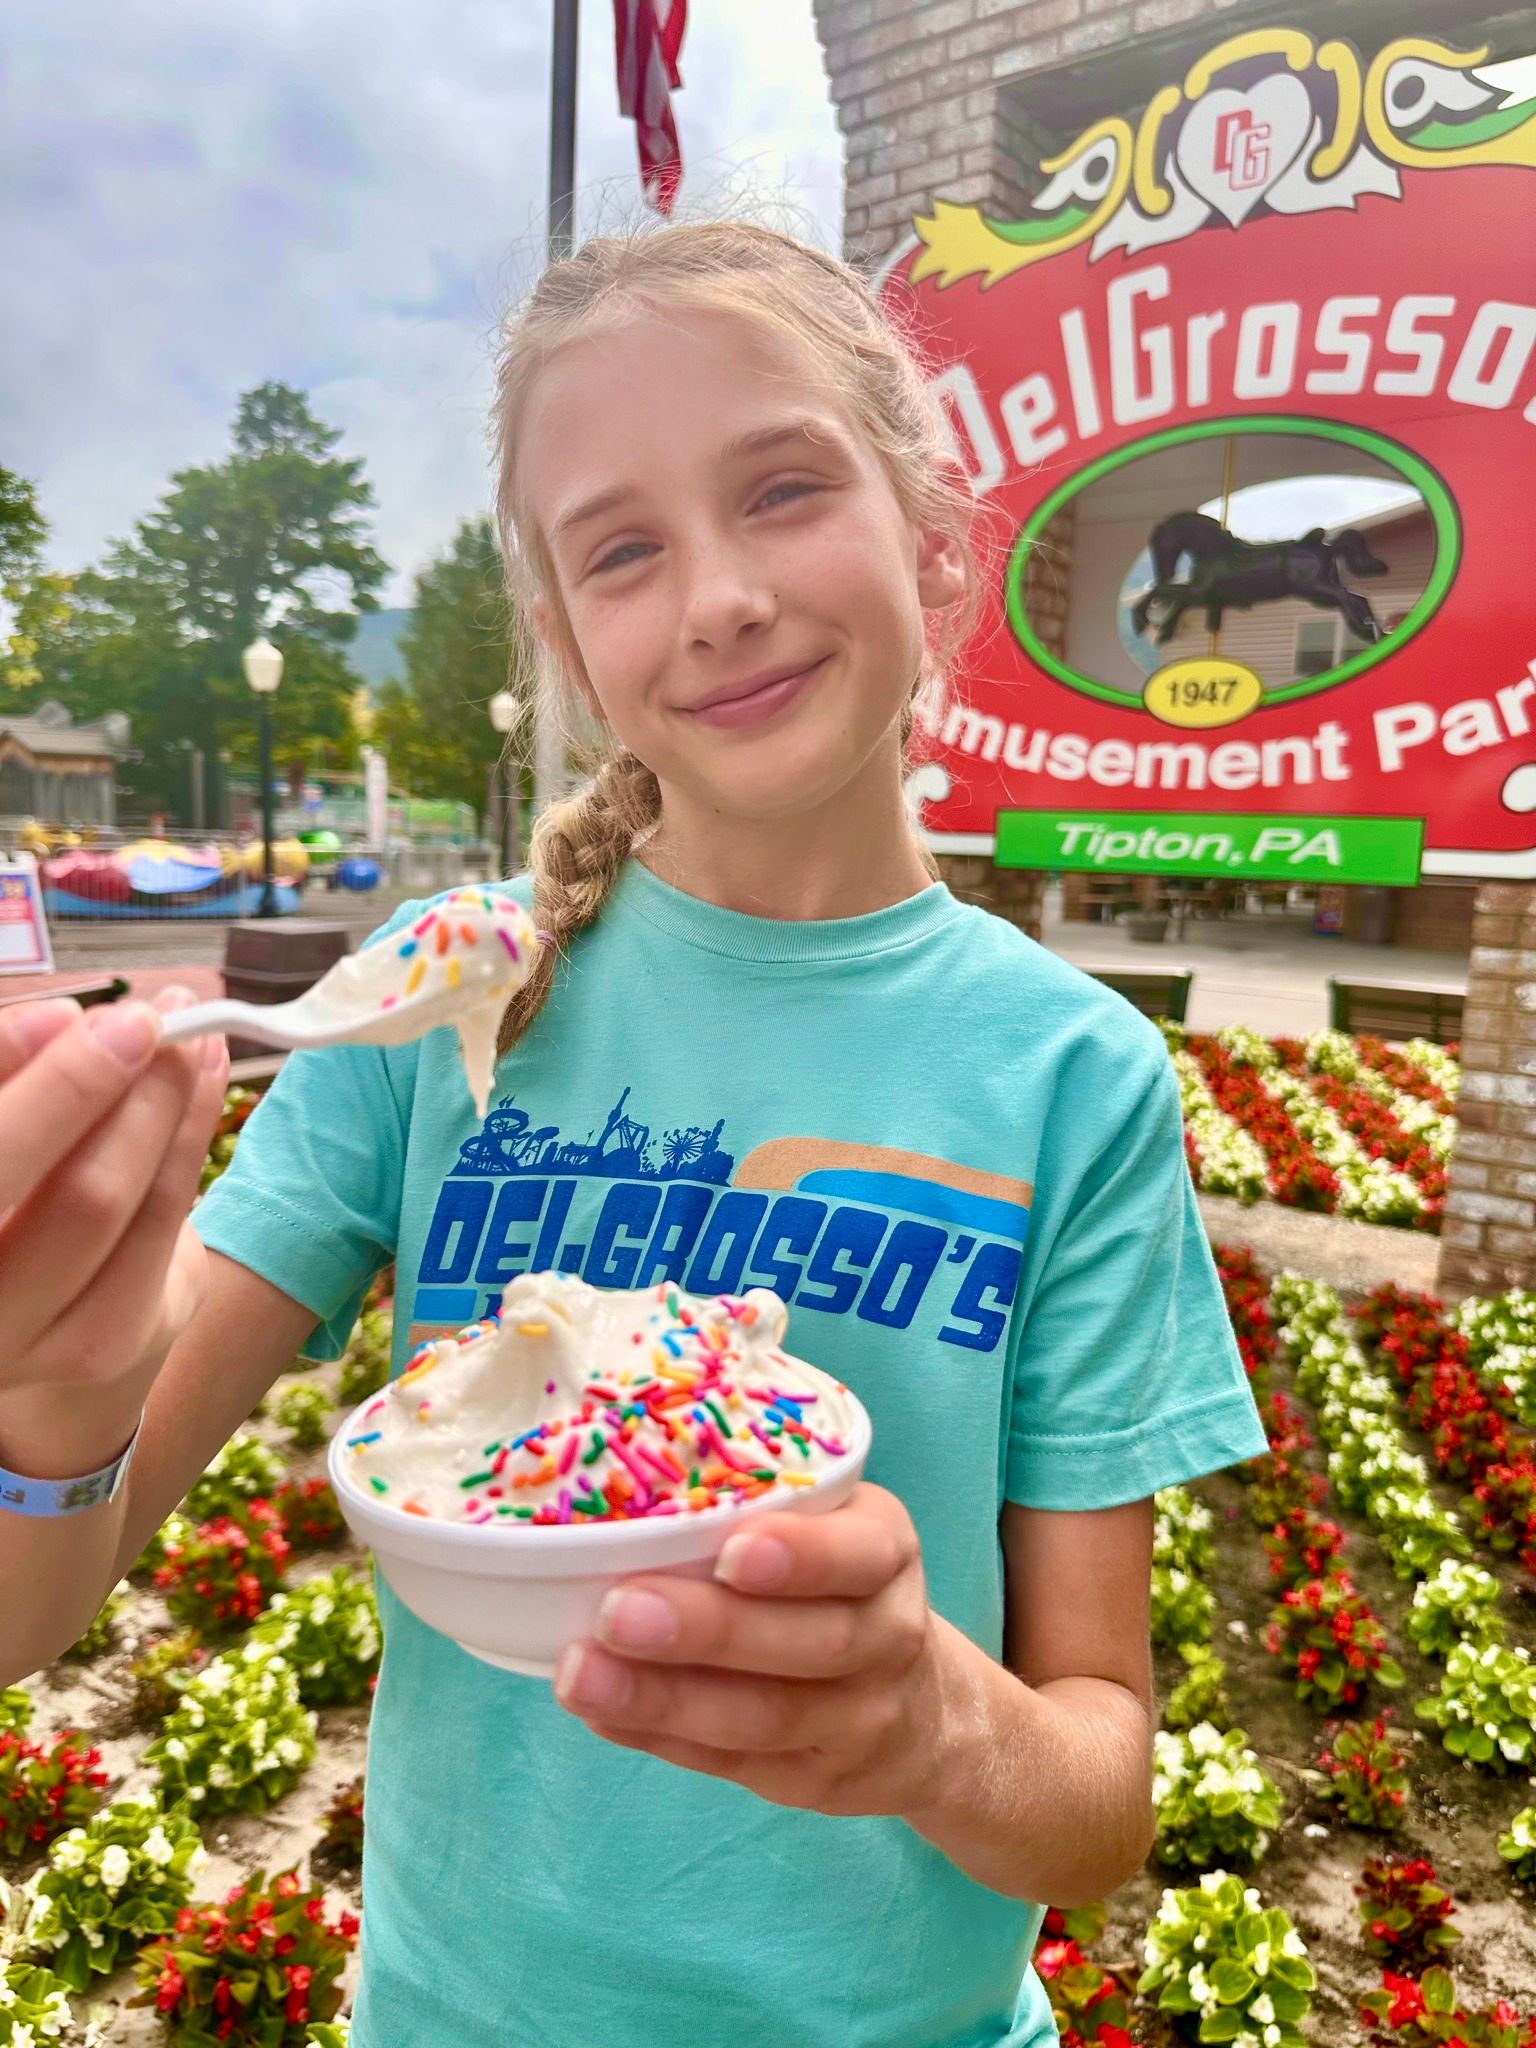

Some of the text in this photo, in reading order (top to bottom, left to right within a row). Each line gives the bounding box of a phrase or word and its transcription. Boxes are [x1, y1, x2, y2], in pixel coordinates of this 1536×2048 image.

[928, 265, 1536, 498] DelGrosso
[1167, 678, 1238, 707] 1947
[1372, 657, 1536, 773] Par
[417, 1178, 1022, 1353] DELGROSSO'S
